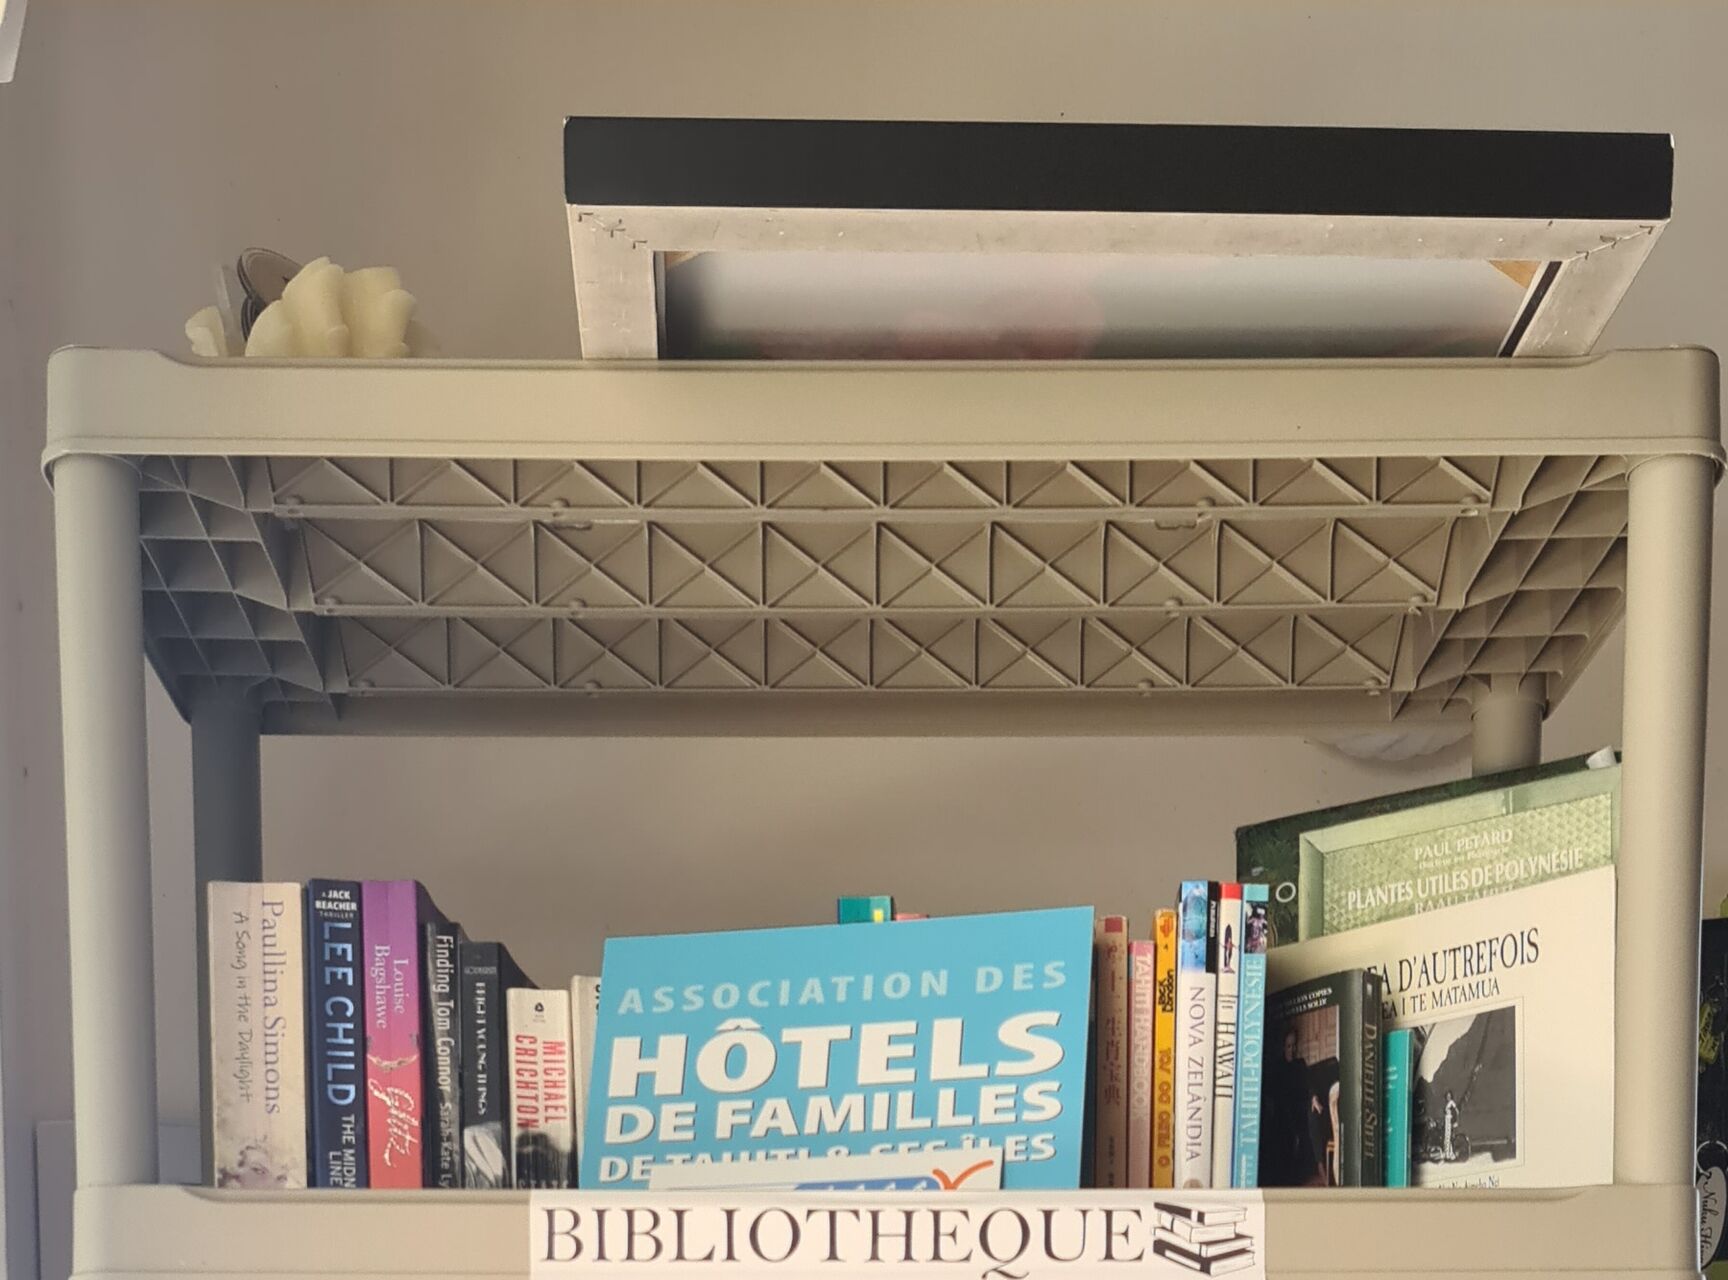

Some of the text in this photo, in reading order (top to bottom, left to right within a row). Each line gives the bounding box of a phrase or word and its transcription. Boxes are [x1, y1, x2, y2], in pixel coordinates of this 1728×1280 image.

[1348, 881, 1414, 911] PLANTES
[1417, 872, 1470, 899] UTILES
[1471, 868, 1494, 889] DE
[1494, 847, 1584, 884] POLYNÉSIE
[1414, 841, 1453, 861] PAUL
[315, 900, 357, 911] REACHER
[328, 890, 351, 900] JACK
[371, 944, 390, 1029] Bagshawe
[393, 959, 409, 1014] Louise
[618, 960, 1068, 1015] ASSOCIATION DES
[1134, 954, 1153, 1009] TAHITI
[1162, 968, 1174, 1013] London
[1398, 927, 1540, 994] D'AUTREFOIS
[231, 912, 254, 1103] A Song in the Daylight
[260, 900, 286, 1114] Paullina Simons
[323, 922, 356, 1106] LEE CHILD
[1410, 978, 1501, 1013] TE MATAMUA
[435, 935, 455, 1169] Finding Tom Connor Sarah-Kate
[515, 1035, 540, 1128] CRICHTON
[543, 1041, 567, 1124] MICHAEL
[607, 1010, 1065, 1099] HÔTELS
[1186, 986, 1205, 1162] NOVA ZELÂNDIA
[1216, 1020, 1236, 1099] HAWAII
[341, 1115, 355, 1144] THE
[604, 1080, 1065, 1145] DE FAMILLES
[330, 1151, 343, 1187] LINE
[600, 1156, 650, 1182] DE
[540, 1207, 1145, 1280] BIBLIOTHEQUE
